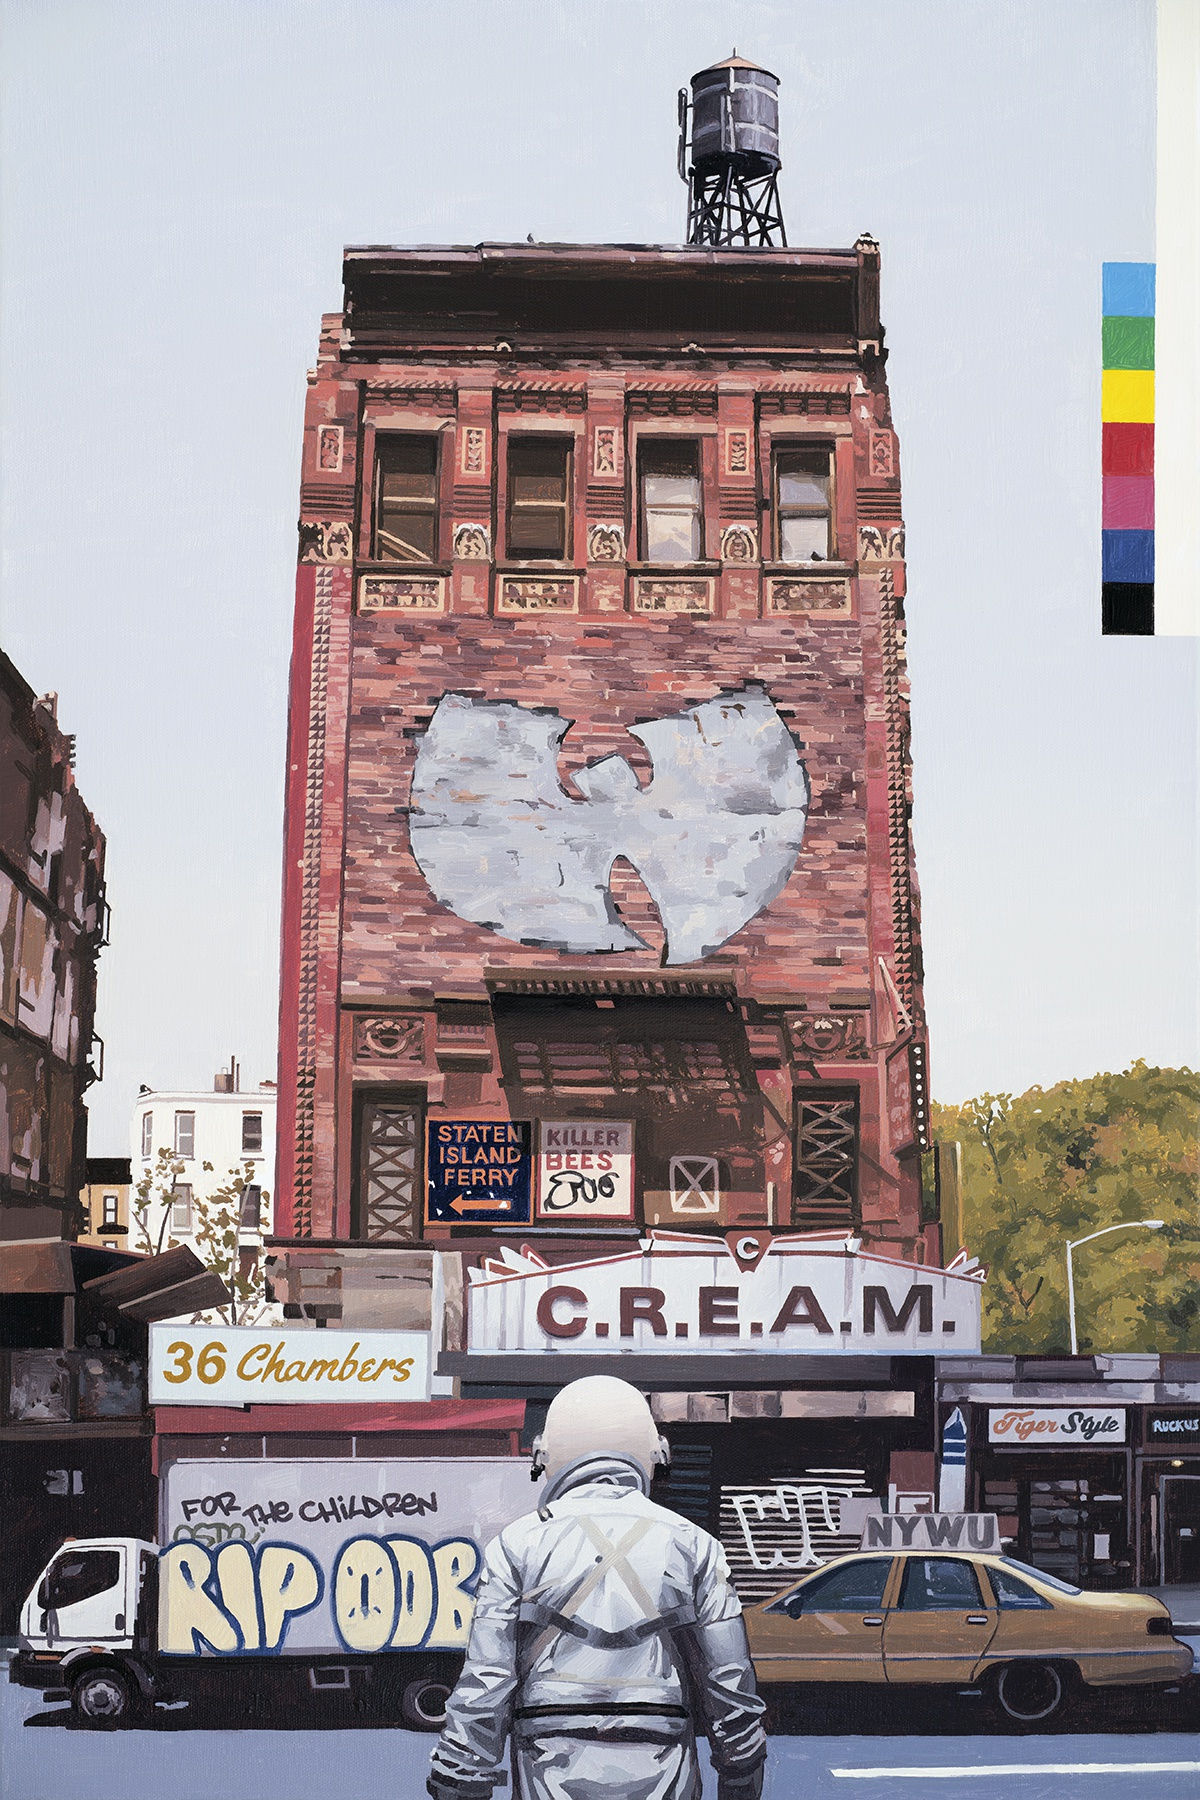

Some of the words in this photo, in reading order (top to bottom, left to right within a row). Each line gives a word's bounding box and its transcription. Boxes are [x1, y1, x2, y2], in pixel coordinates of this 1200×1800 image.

[437, 1125, 523, 1143] STATEN
[547, 1129, 620, 1146] KILLER
[439, 1147, 522, 1165] ISLAND
[546, 1150, 614, 1170] BEES
[444, 1168, 519, 1186] FERRY
[736, 1236, 760, 1260] C
[536, 1284, 956, 1338] C.R.E.A.M.
[162, 1341, 228, 1385] 36
[236, 1341, 415, 1383] Chambers
[992, 1410, 1059, 1441] Tiger
[1060, 1411, 1120, 1441] Style
[1152, 1419, 1200, 1433] RUCKUS
[180, 1491, 241, 1521] FOR
[866, 1515, 995, 1548] NYWU
[159, 1537, 325, 1657] RIP
[330, 1532, 482, 1655] ODB
